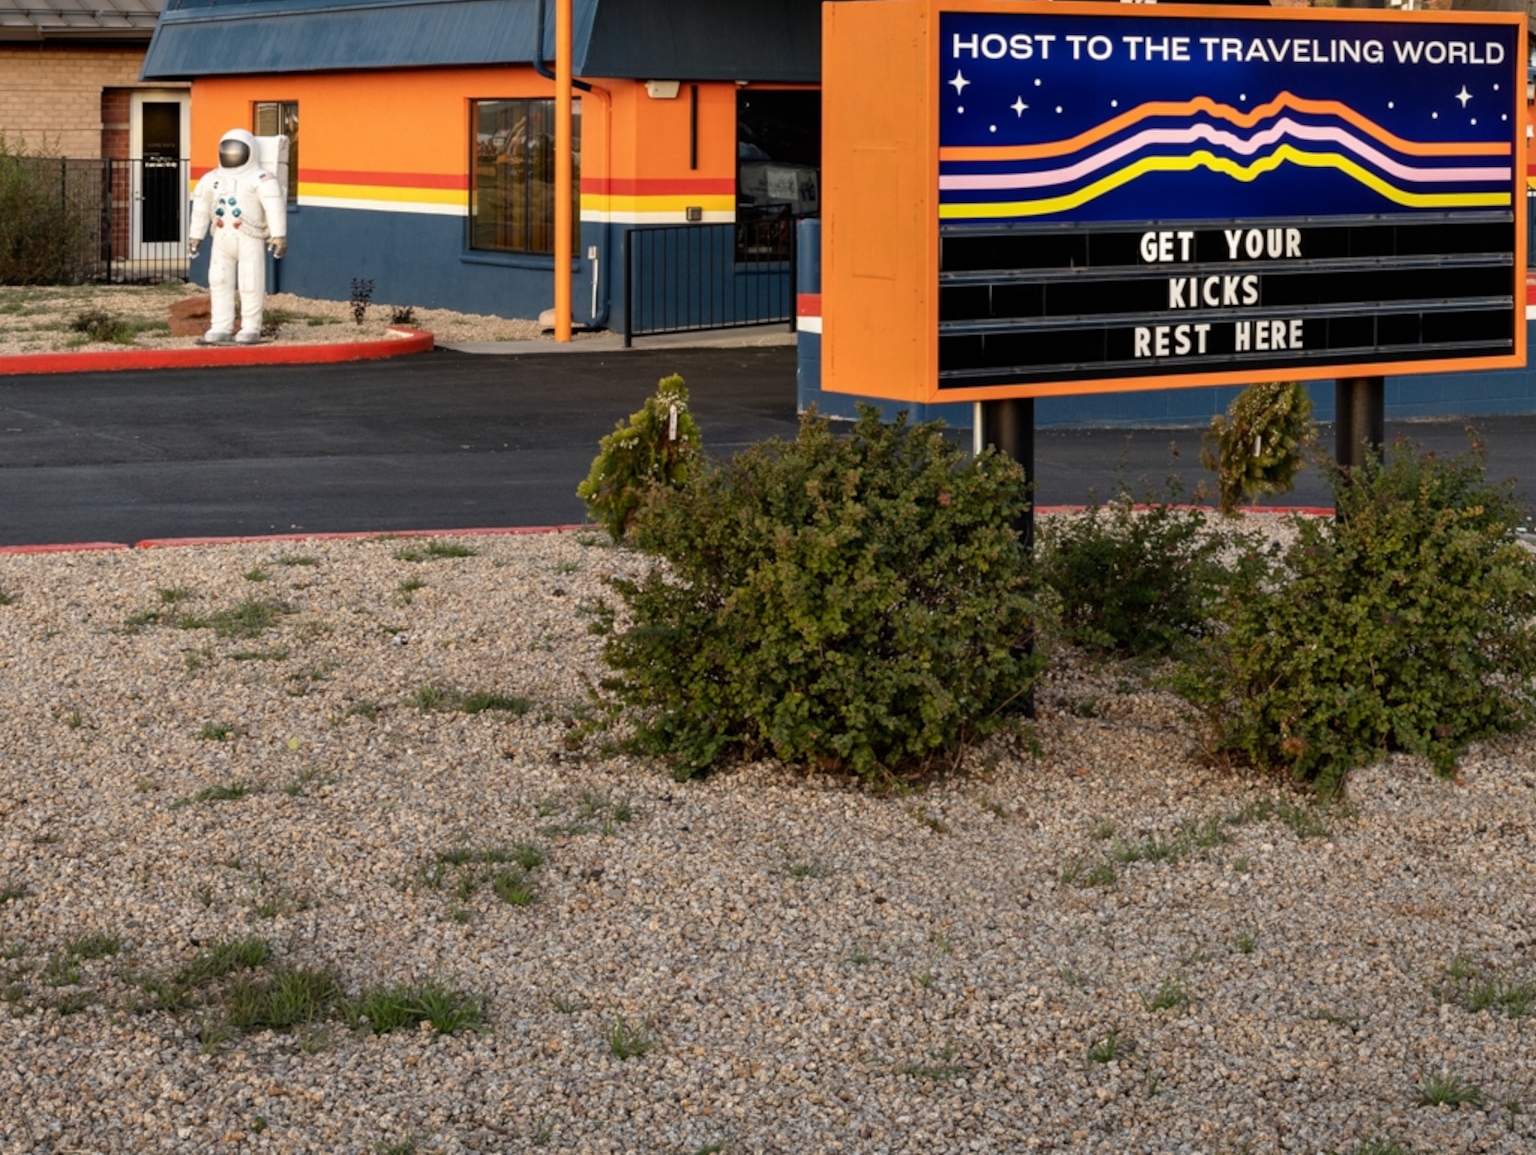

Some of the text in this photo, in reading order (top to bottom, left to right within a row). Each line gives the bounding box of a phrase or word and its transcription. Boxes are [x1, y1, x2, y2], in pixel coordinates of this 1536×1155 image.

[953, 33, 1504, 64] HOST TO THE TRAVELING WORLD
[1140, 228, 1301, 263] GET YOUR
[1169, 274, 1258, 308] KICKS
[1134, 319, 1303, 357] REST HERE
